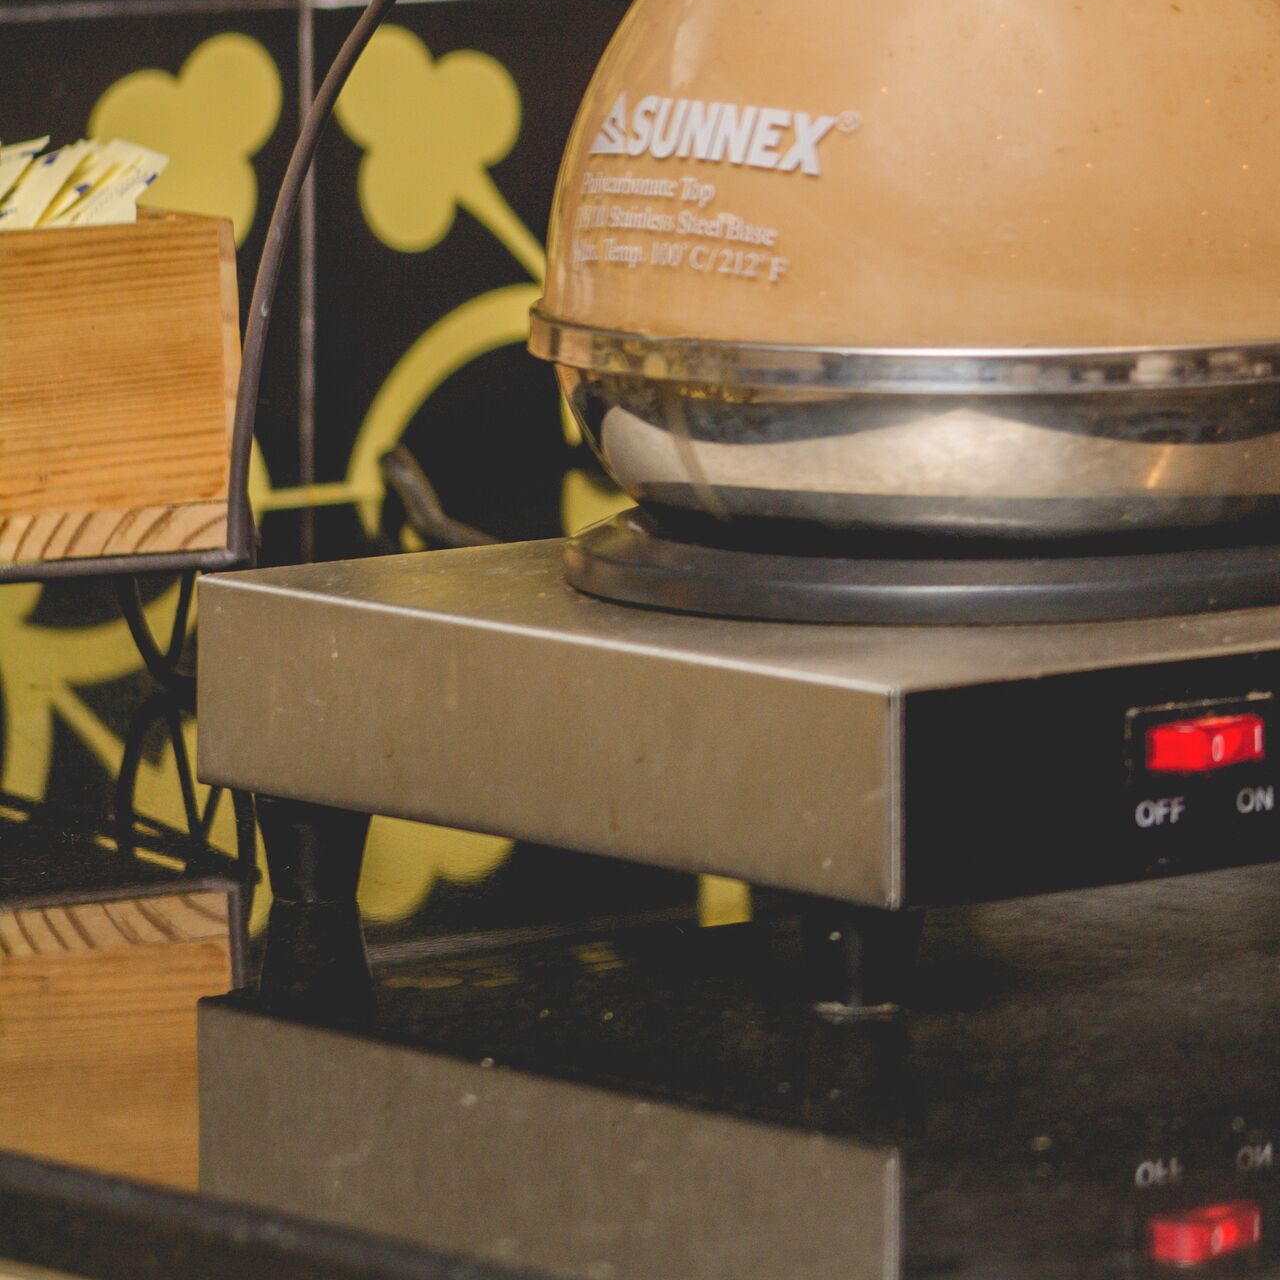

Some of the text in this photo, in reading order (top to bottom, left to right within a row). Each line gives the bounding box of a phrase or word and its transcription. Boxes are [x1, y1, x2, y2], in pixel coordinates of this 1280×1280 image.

[625, 95, 836, 177] SUNNEX
[680, 176, 716, 209] Top
[724, 214, 779, 247] Base
[1135, 785, 1275, 828] OFF ON
